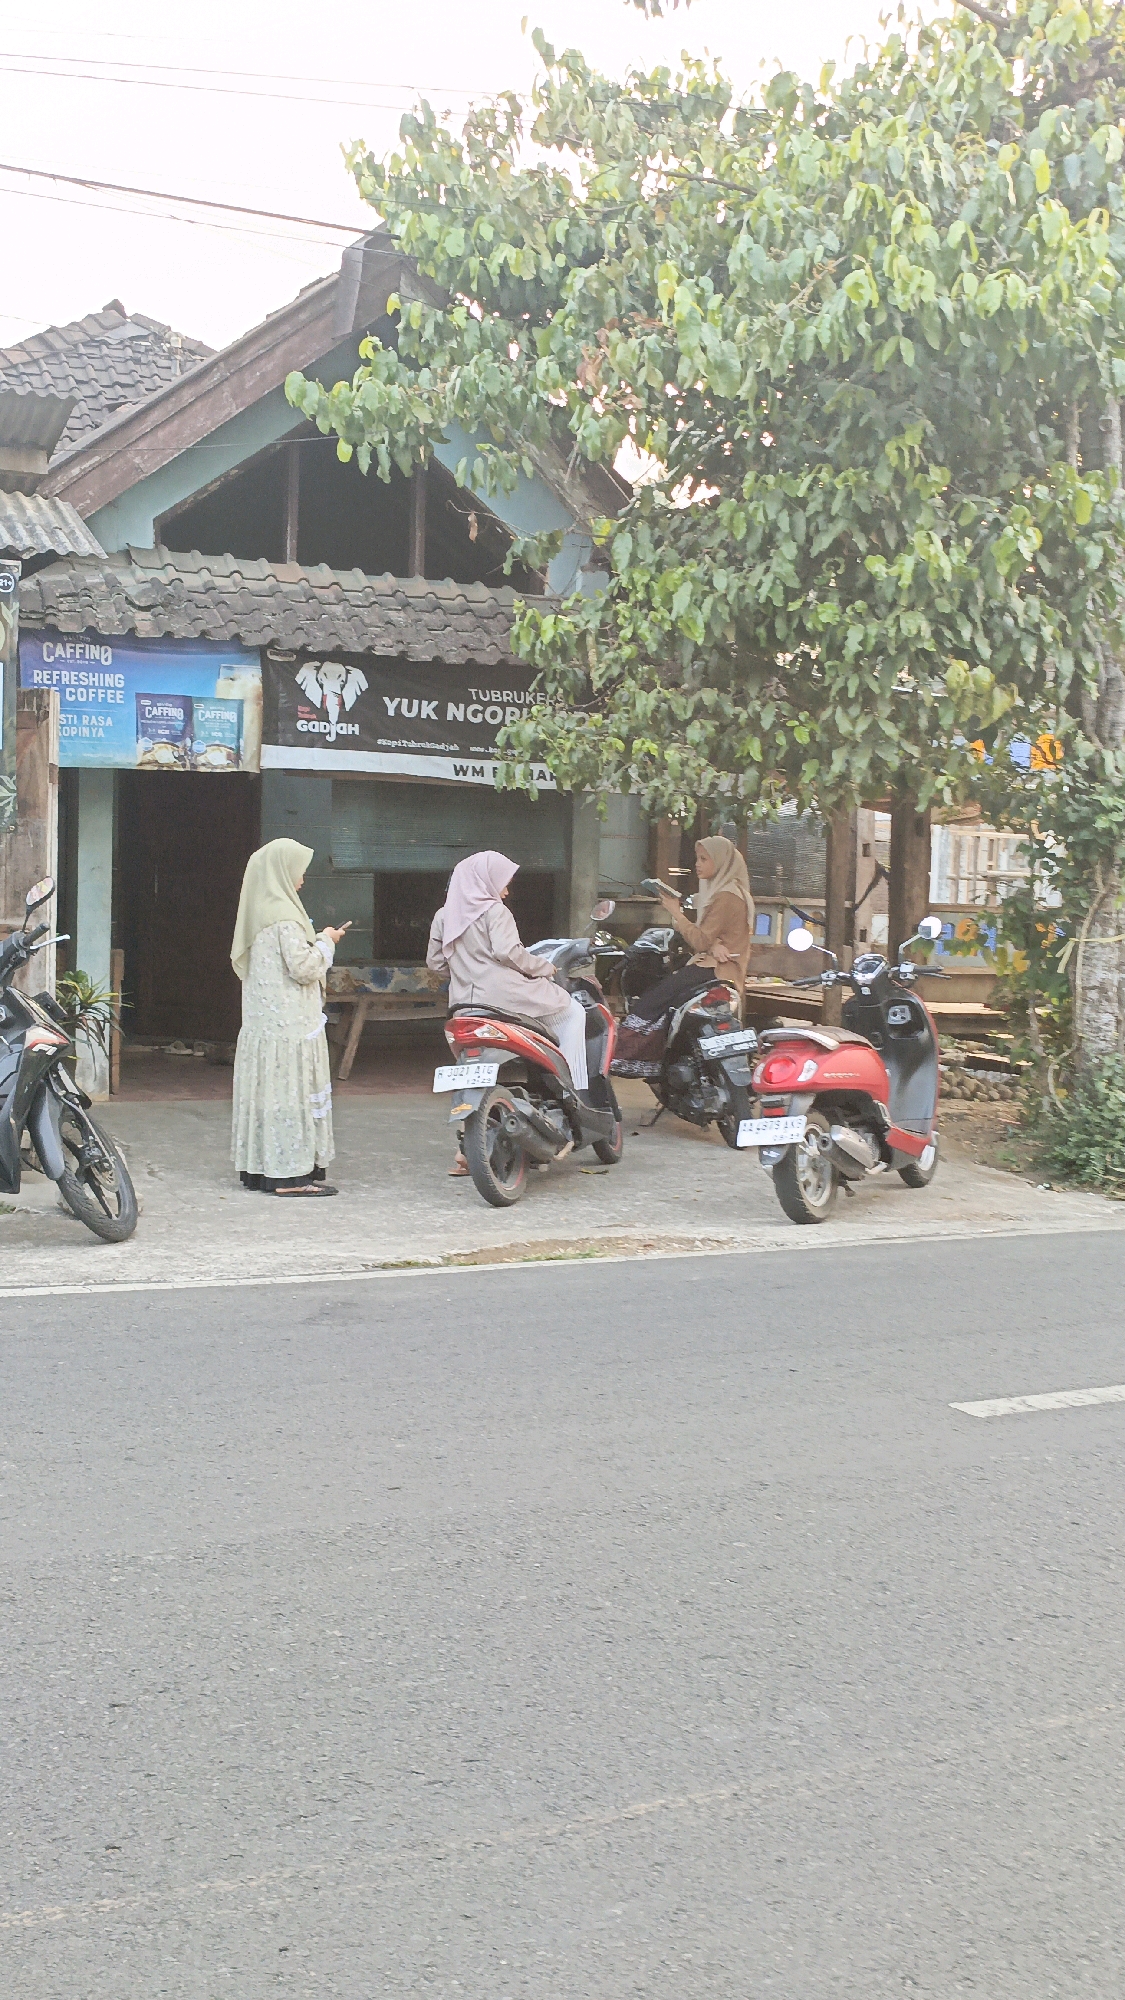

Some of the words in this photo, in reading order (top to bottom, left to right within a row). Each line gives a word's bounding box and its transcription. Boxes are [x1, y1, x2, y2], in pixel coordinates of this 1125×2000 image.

[33, 669, 125, 689] REFRESHING
[65, 687, 125, 704] COFFEE
[383, 696, 439, 721] YUK
[82, 714, 114, 727] RASA
[453, 763, 485, 778] WM
